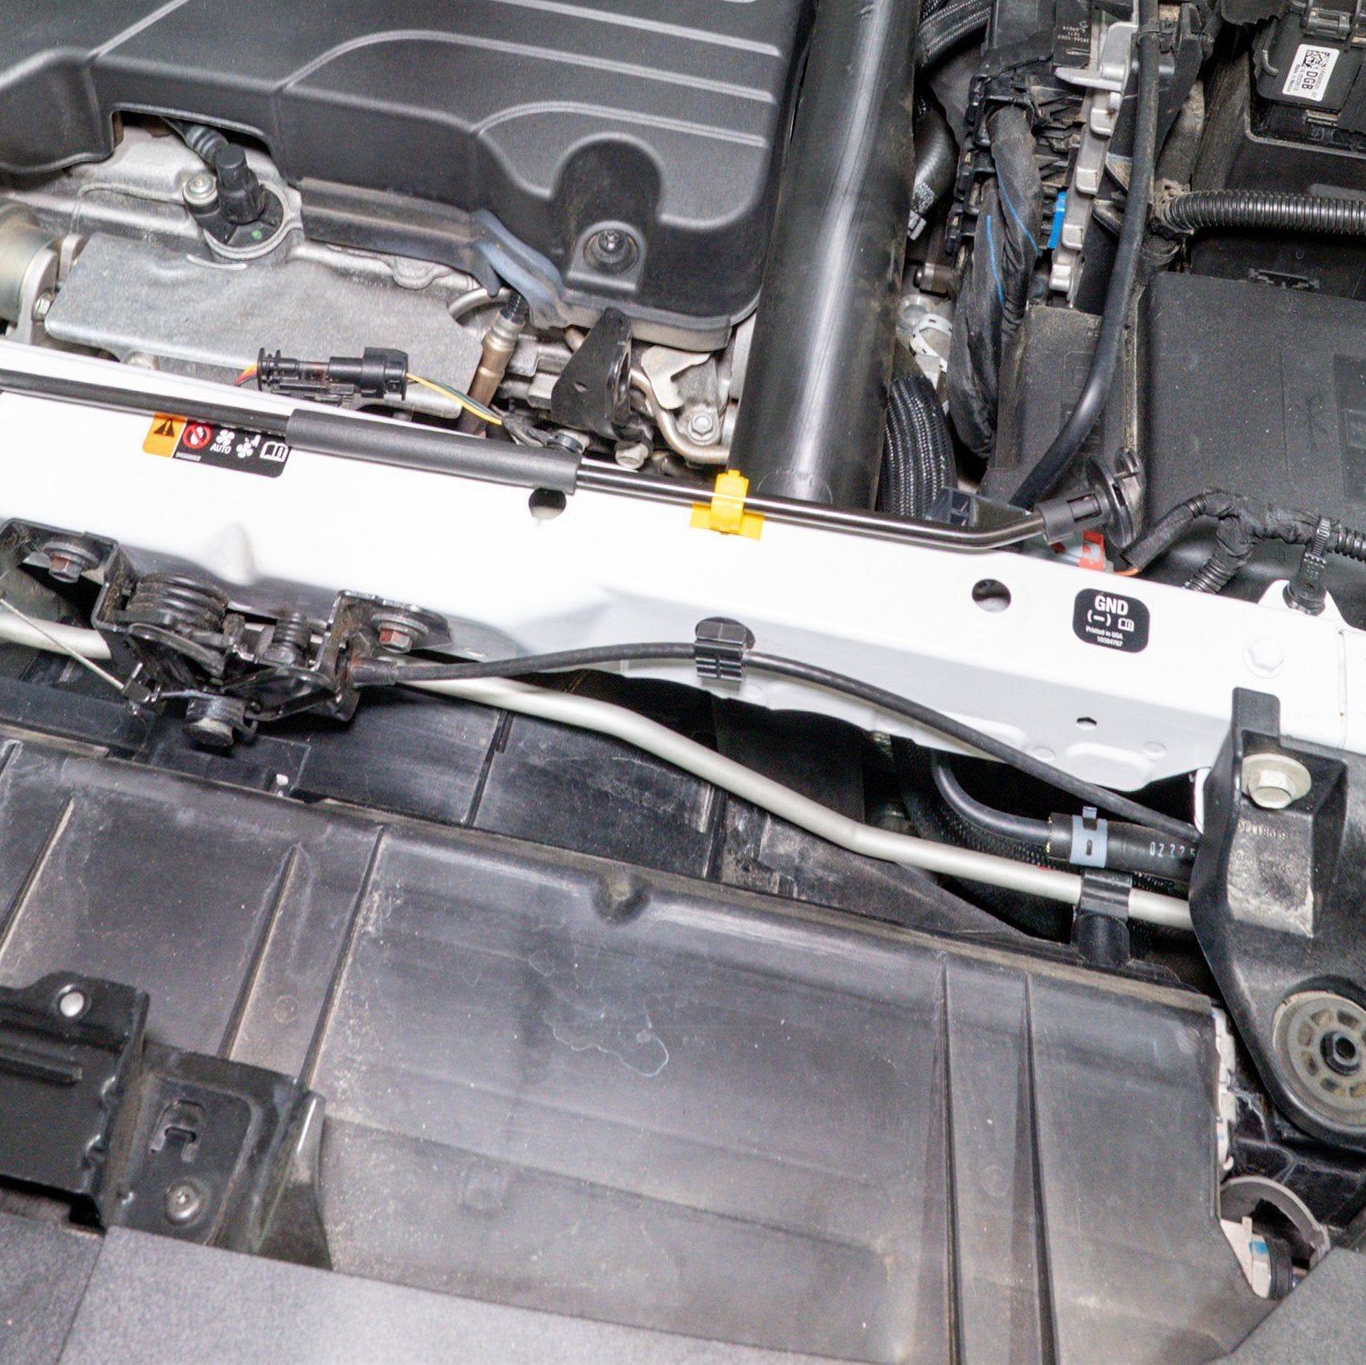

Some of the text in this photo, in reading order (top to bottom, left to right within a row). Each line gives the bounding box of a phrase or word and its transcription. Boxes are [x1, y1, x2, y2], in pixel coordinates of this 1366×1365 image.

[1301, 71, 1319, 90] DGB
[210, 444, 232, 455] AUTO
[1094, 595, 1129, 616] GND
